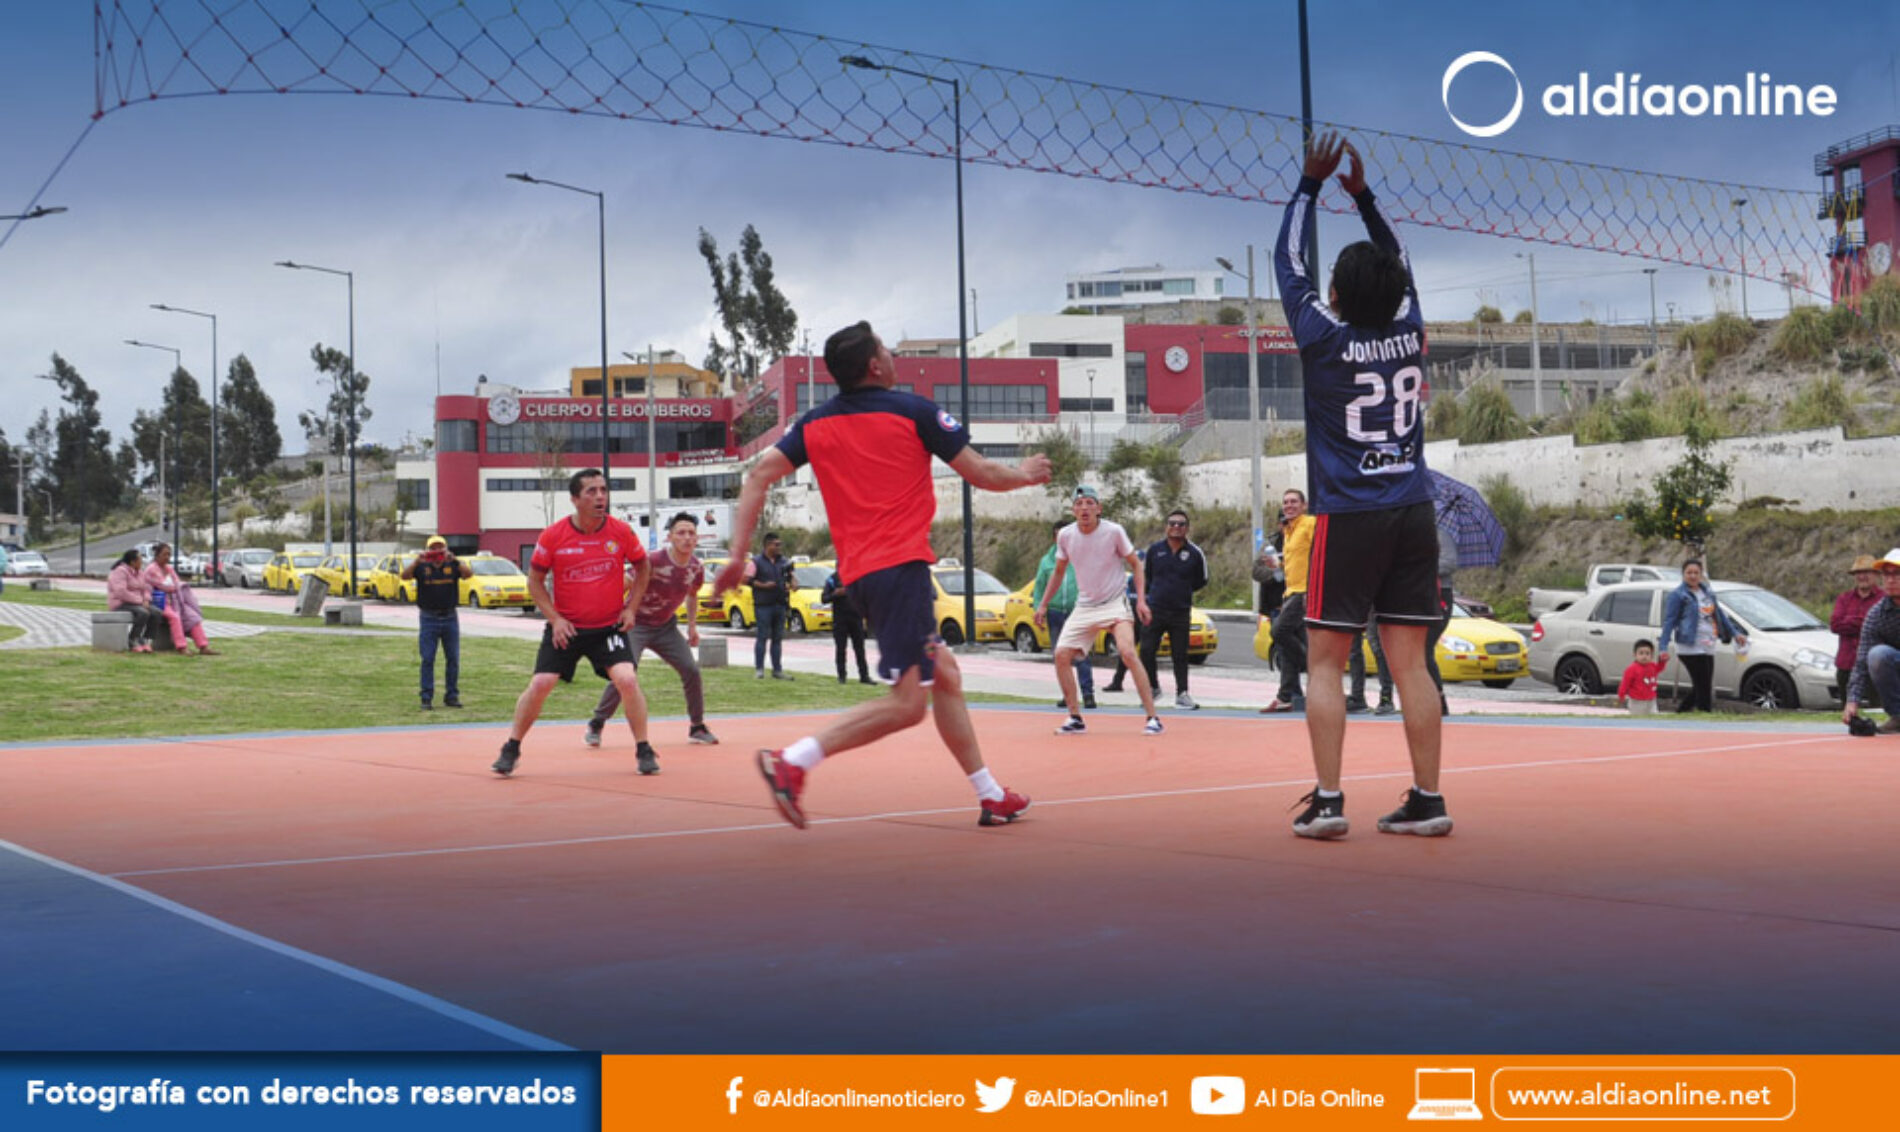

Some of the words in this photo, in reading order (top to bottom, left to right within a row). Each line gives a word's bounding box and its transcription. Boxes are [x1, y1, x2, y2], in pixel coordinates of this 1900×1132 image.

[526, 403, 593, 417] CUERPO
[622, 403, 712, 417] BOMBEROS
[1346, 366, 1422, 442] 28
[606, 635, 625, 652] 14
